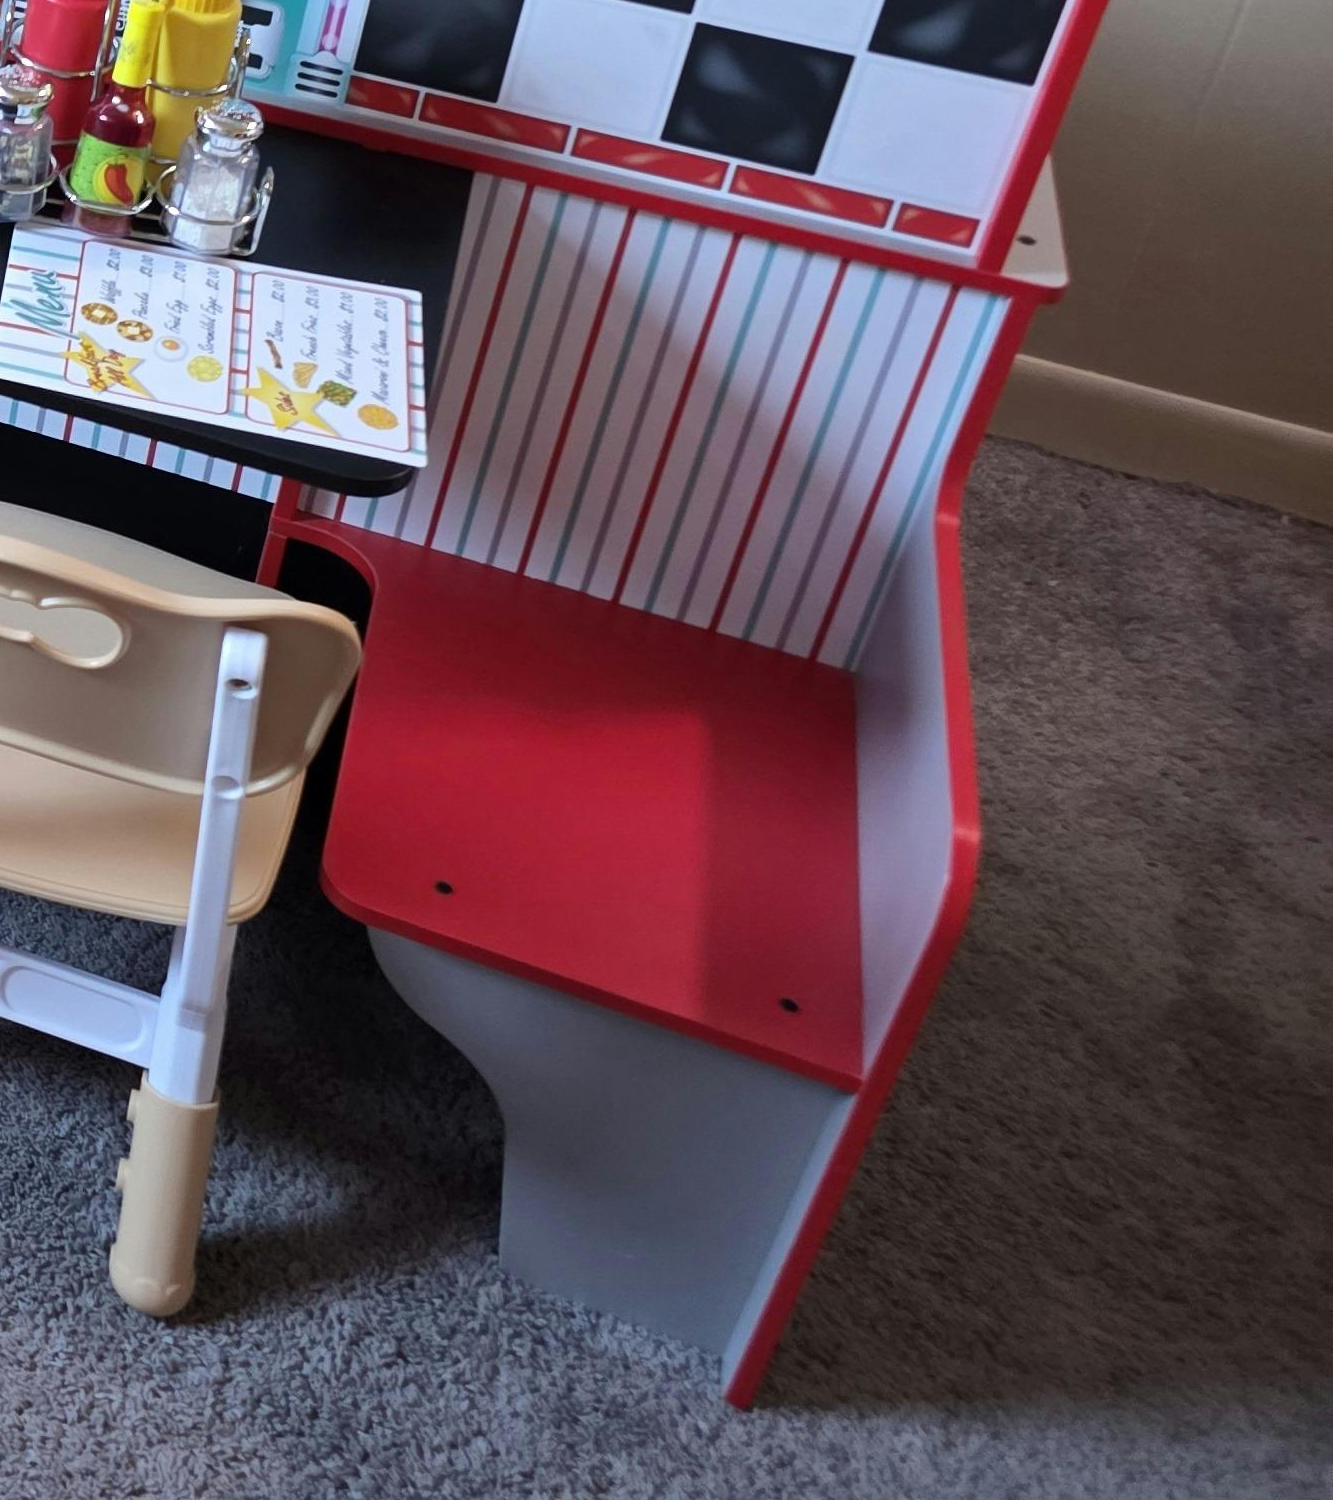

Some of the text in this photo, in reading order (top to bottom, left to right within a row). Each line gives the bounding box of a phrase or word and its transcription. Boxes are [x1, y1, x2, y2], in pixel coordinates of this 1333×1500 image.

[9, 271, 81, 341] Menu
[166, 300, 189, 314] Egg
[164, 311, 181, 334] Fried
[197, 314, 216, 355] Scrambled
[300, 335, 317, 361] French
